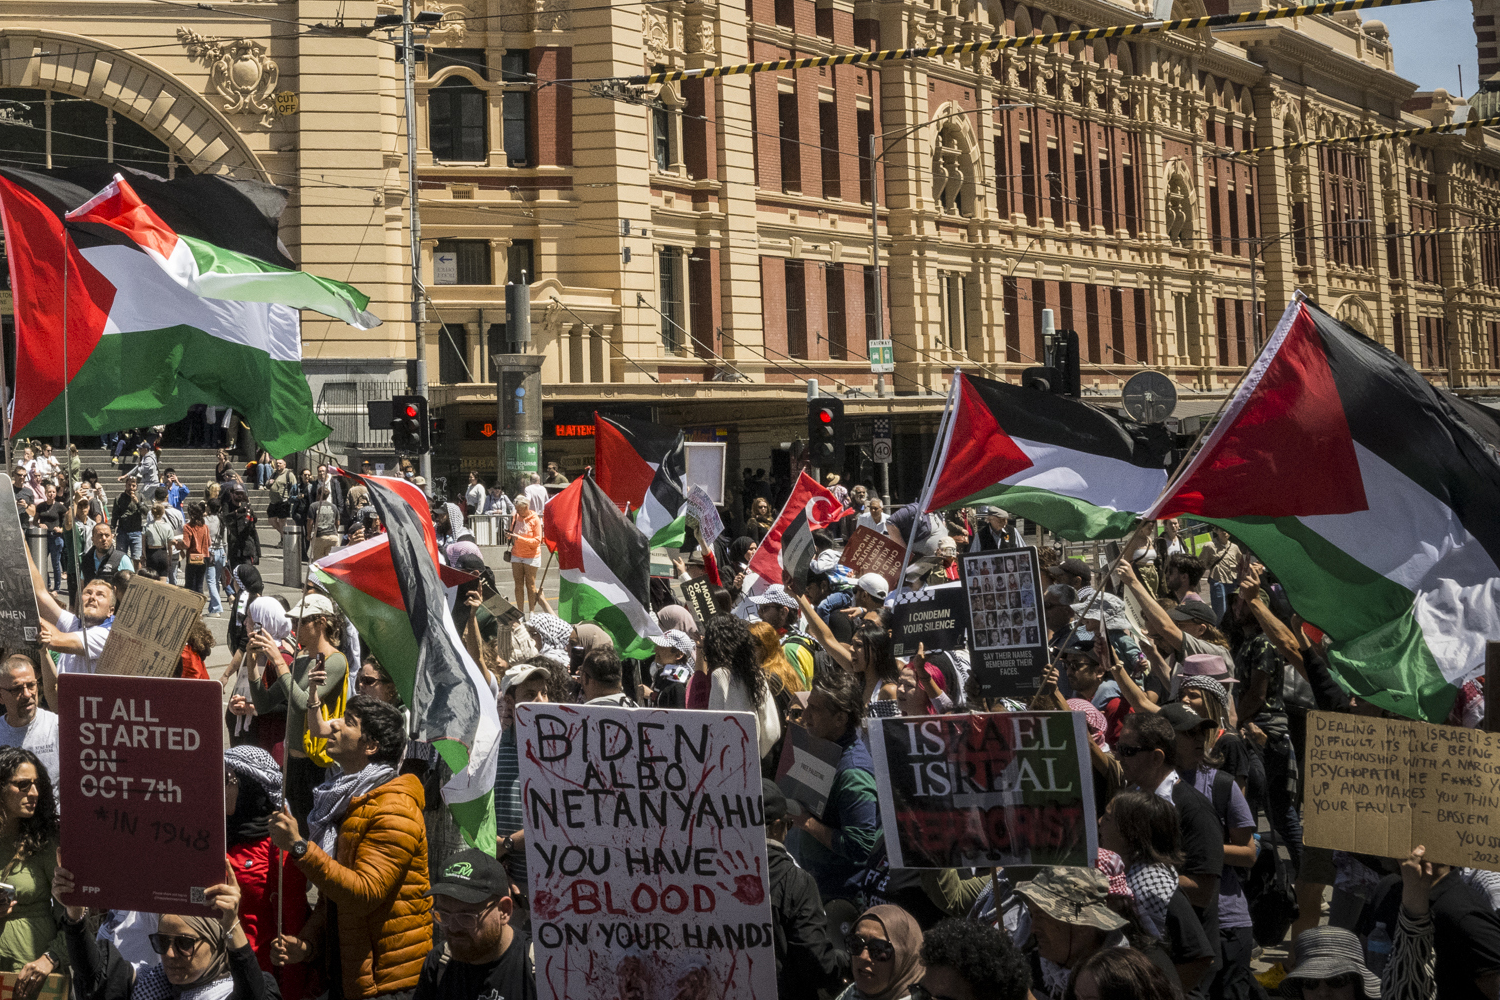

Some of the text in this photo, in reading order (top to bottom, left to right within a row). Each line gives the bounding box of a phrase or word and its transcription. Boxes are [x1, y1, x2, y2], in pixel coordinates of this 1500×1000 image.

[278, 95, 294, 103] CUT
[876, 447, 889, 455] 40
[869, 541, 885, 563] EVERY
[872, 547, 891, 571] KILLED
[882, 549, 898, 570] CHILD
[888, 562, 901, 576] ONE
[694, 583, 701, 593] OF
[701, 584, 717, 614] MONTH
[120, 584, 148, 628] THIS
[688, 585, 704, 622] CONFLICT
[909, 609, 951, 622] I CONDEMN
[903, 620, 955, 634] YOUR SILENCE
[986, 660, 1016, 668] REMEMBER
[1012, 650, 1033, 658] NAMES,
[80, 696, 159, 722] IT ALL
[79, 722, 200, 751] STARTED
[535, 714, 708, 764] BIDEN
[904, 716, 1067, 756] ISRAEL
[80, 748, 117, 772] ON
[1442, 759, 1451, 768] A
[1448, 745, 1492, 759] BEING
[80, 774, 182, 803] OCT 7th
[583, 761, 686, 791] ALBO
[909, 757, 1073, 797] ISREAL
[1409, 773, 1427, 784] HE
[1313, 782, 1329, 796] UP
[1341, 782, 1369, 795] AND
[1375, 786, 1426, 798] MAKES
[1436, 790, 1458, 803] YOU
[530, 788, 765, 831] NETANYAHU
[1312, 799, 1349, 814] YOUR
[1437, 810, 1488, 825] BASSEM
[151, 821, 210, 850] 1948
[897, 805, 1081, 850] TERRORIST
[534, 843, 717, 878] YOU HAVE
[571, 879, 716, 915] BLOOD
[539, 922, 772, 949] ON YOUR HANDS
